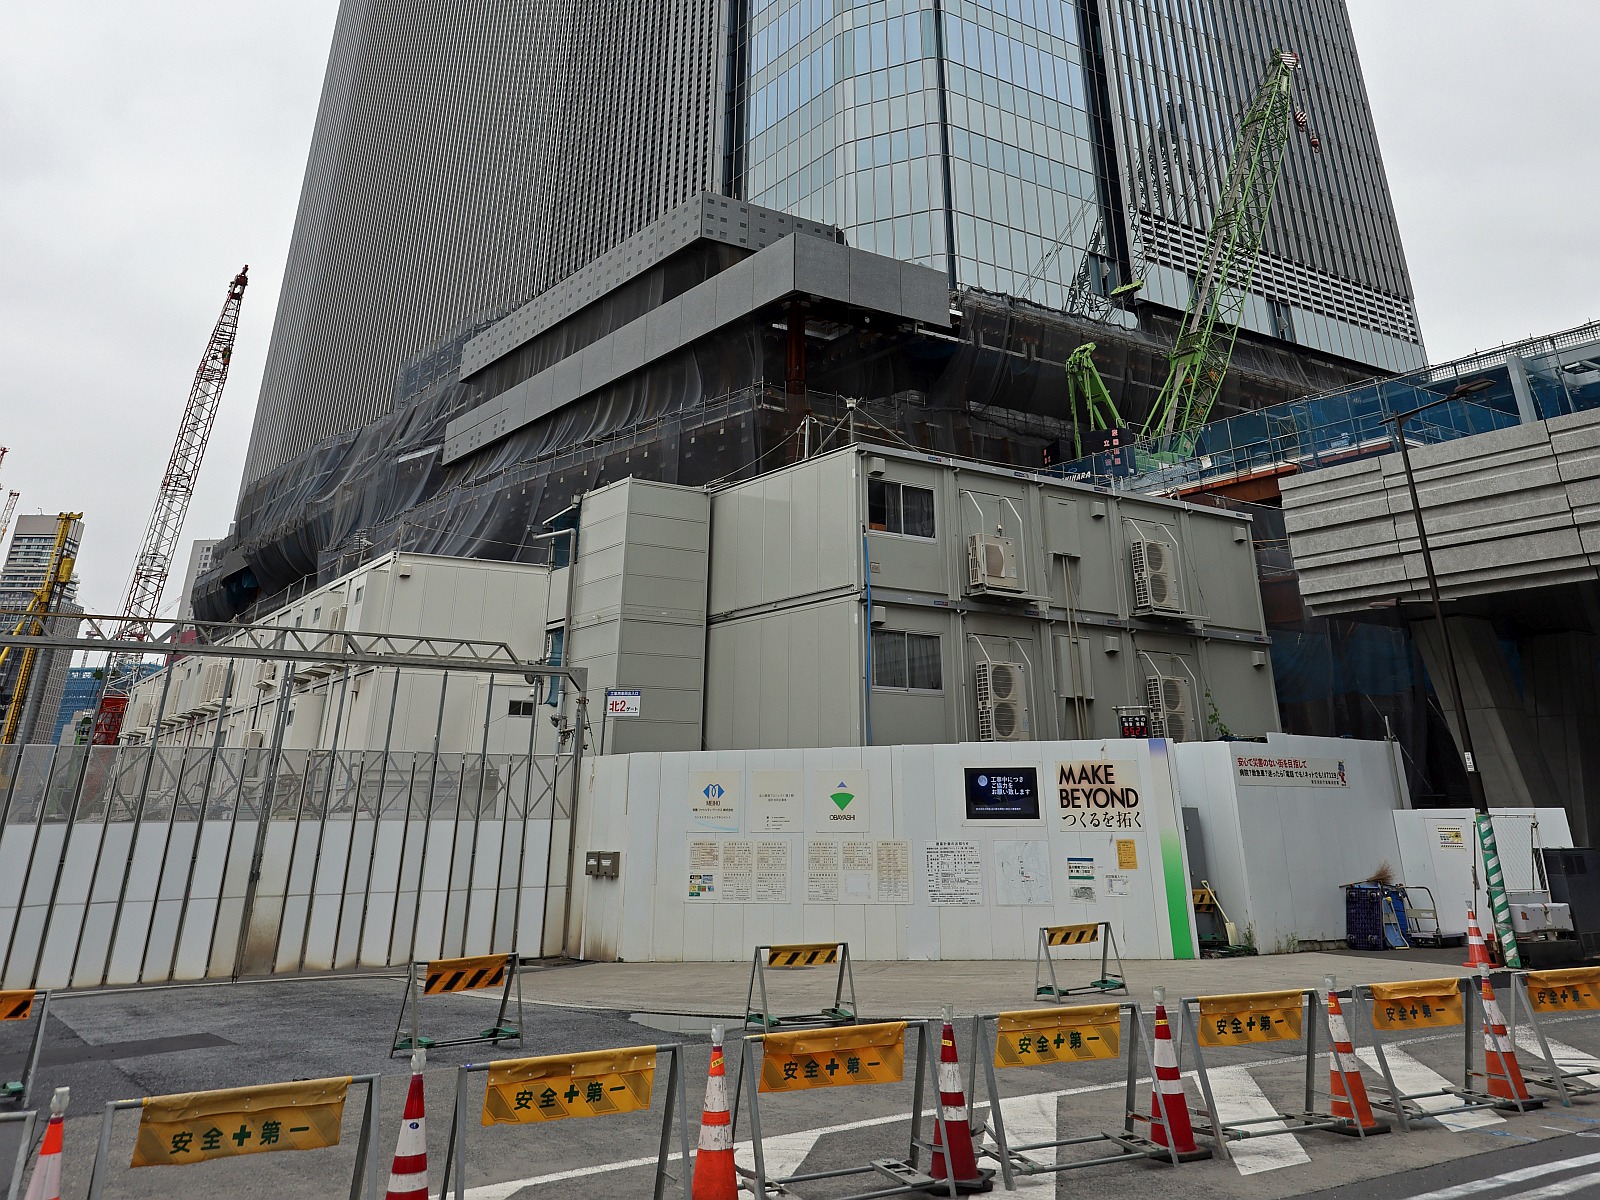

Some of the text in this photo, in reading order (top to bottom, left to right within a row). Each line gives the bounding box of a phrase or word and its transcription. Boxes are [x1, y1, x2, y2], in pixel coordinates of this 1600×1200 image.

[1059, 765, 1115, 785] MAKE
[1060, 788, 1139, 809] BEYOND
[1062, 811, 1142, 828] つくるを拓く
